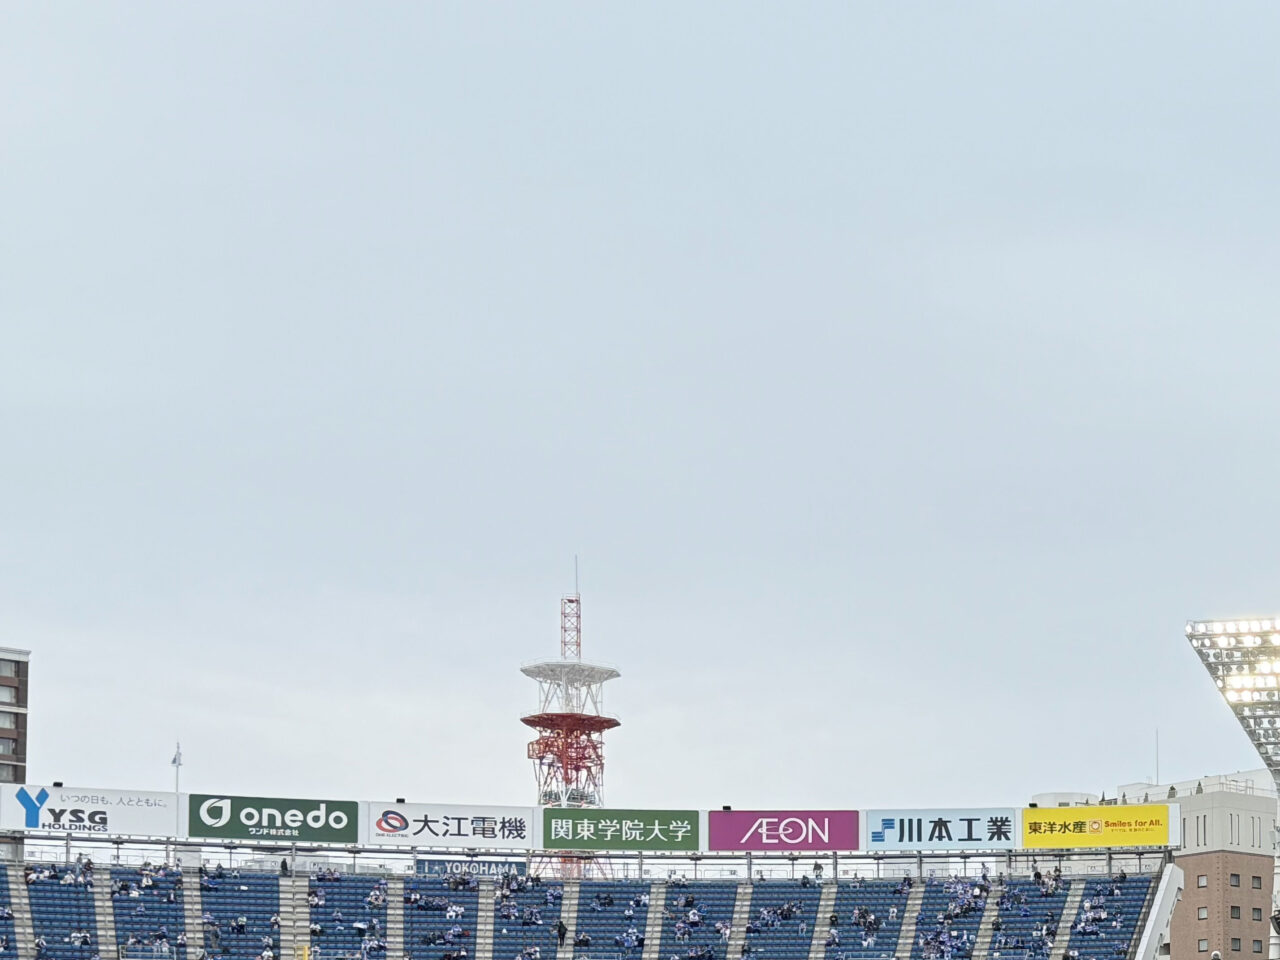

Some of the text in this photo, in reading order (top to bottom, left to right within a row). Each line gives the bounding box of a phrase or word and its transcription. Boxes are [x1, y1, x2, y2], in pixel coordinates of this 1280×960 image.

[47, 809, 108, 827] YSG
[240, 803, 348, 830] onedo
[1104, 819, 1163, 828] Smiles for All.
[42, 822, 108, 833] HOLDINGS
[412, 814, 527, 840] 大江電機
[551, 818, 691, 841] 関東学院大学
[899, 816, 1013, 843] 川本工業
[1028, 820, 1087, 835] 東洋水産
